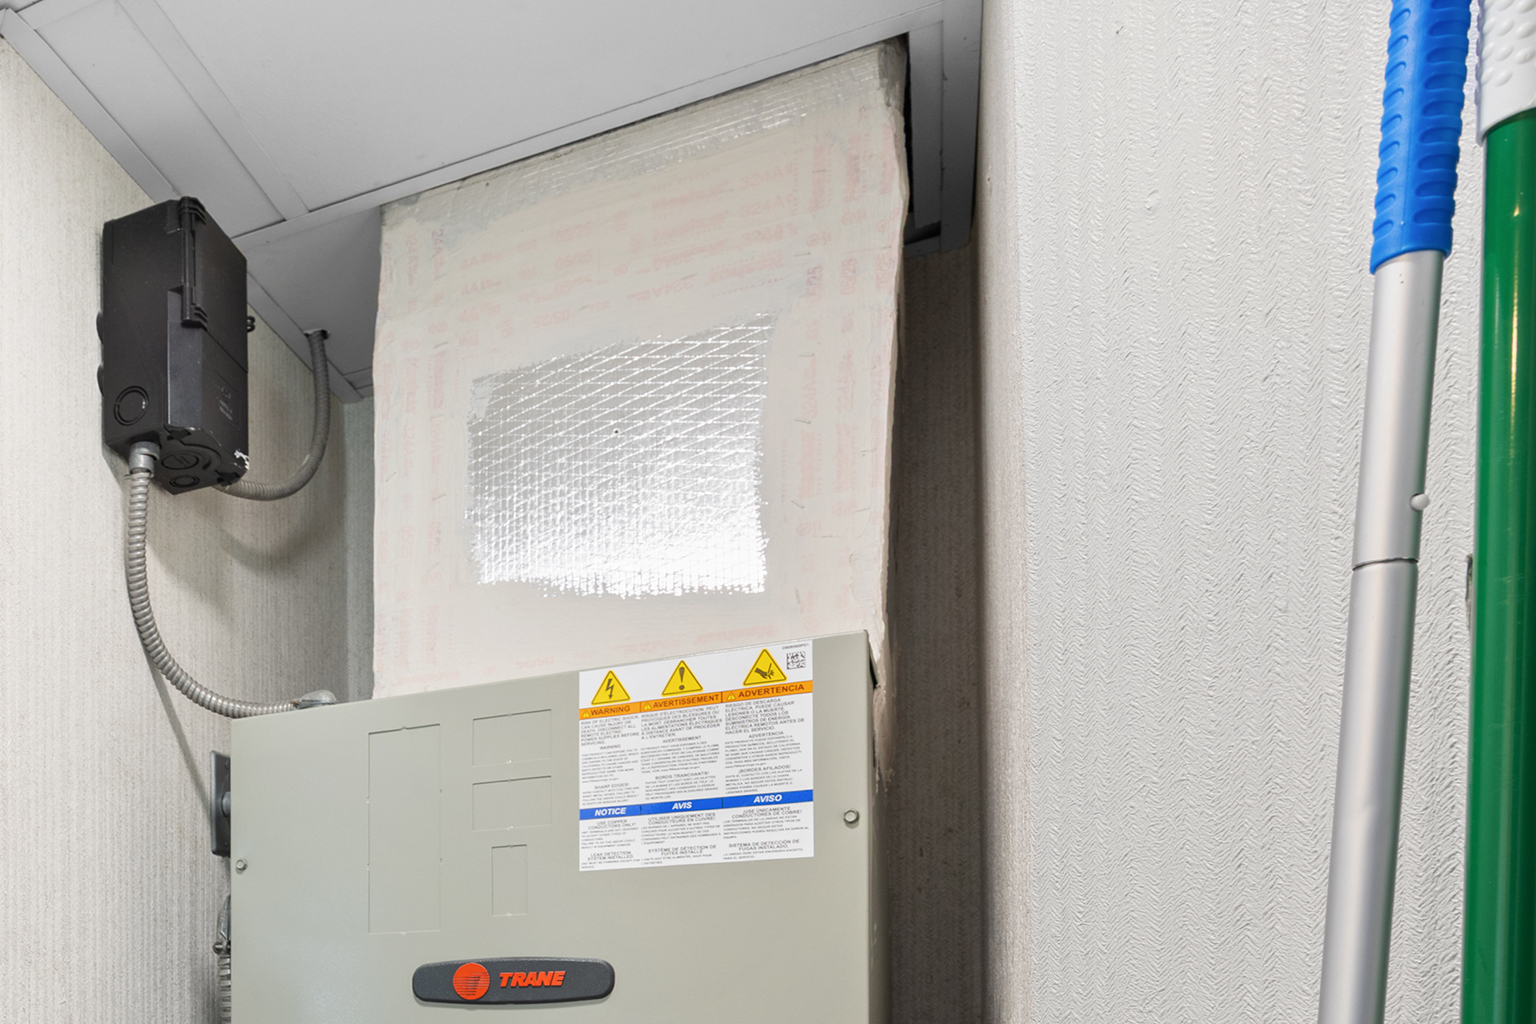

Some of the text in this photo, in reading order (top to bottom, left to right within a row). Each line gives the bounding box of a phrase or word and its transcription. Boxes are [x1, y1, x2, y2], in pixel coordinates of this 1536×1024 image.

[738, 684, 804, 699] ADVERTENCIA
[652, 694, 719, 709] AVERTISSEMENT
[591, 705, 631, 716] WARNING
[753, 794, 782, 804] AVISO
[672, 802, 692, 810] AVIS
[594, 807, 626, 817] NOTICE
[499, 971, 566, 987] TRANE
